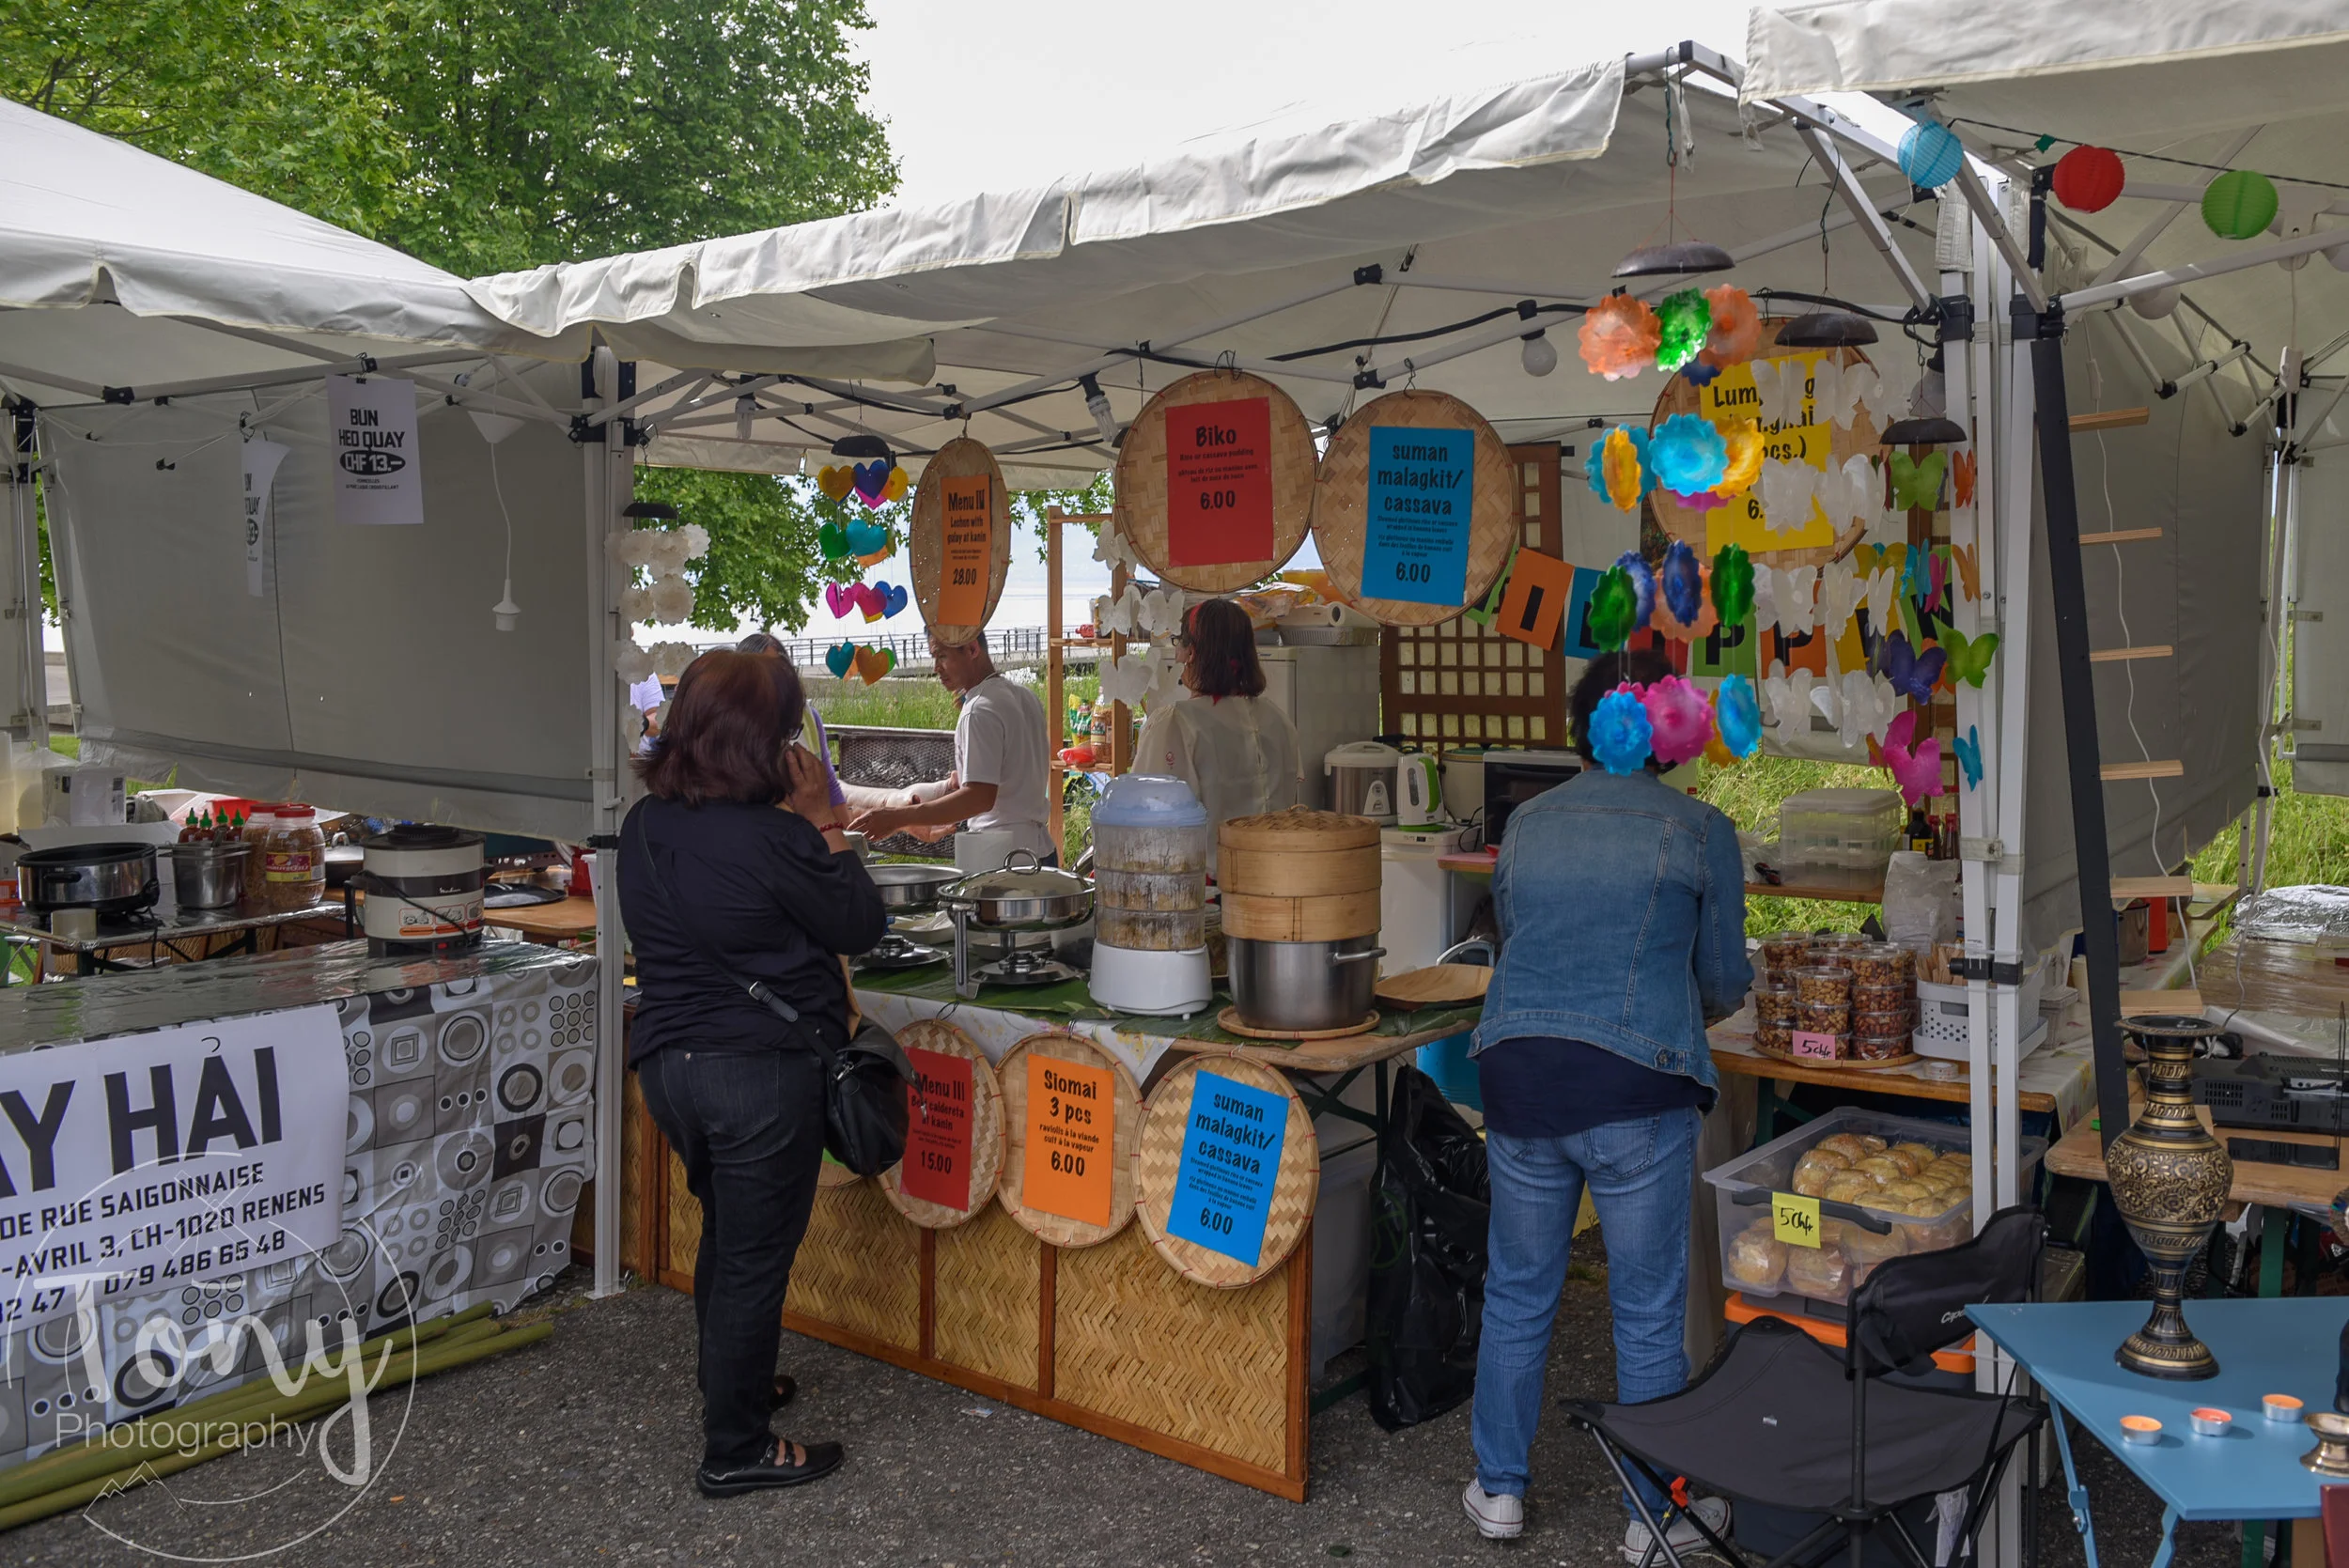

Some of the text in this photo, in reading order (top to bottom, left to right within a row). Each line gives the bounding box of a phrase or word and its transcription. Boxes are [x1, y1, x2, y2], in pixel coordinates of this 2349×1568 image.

[363, 430, 405, 451] QUAY
[1196, 425, 1237, 447] Biko
[345, 453, 367, 472] CHF
[1392, 444, 1448, 462] suman
[1377, 466, 1464, 491] malagkit/
[948, 491, 974, 512] Menu
[1200, 489, 1236, 510] 6.00
[1384, 496, 1452, 515] cassava
[953, 567, 977, 585] 28.00
[1396, 562, 1431, 583] 6.00
[1801, 1039, 1818, 1054] 5
[953, 1080, 965, 1102] III
[1044, 1069, 1097, 1100] Siomai
[929, 1101, 964, 1119] caldereta
[1050, 1096, 1092, 1125] 3 pcs
[1213, 1093, 1264, 1123] suman
[931, 1115, 953, 1131] kanin
[1195, 1113, 1276, 1151] malagkit/
[1039, 1124, 1064, 1136] raviolis
[1070, 1128, 1077, 1139] la
[1078, 1132, 1099, 1144] viande
[1044, 1135, 1057, 1144] cuit
[1064, 1138, 1070, 1147] la
[1071, 1141, 1094, 1153] vapeur
[921, 1150, 952, 1174] 15.00
[1050, 1150, 1085, 1177] 6.00
[1198, 1141, 1261, 1174] cassava
[0, 1161, 264, 1239] DE RUE SAIGONNAISE
[99, 1234, 124, 1259] 3,
[131, 1205, 235, 1251] CH-1020
[242, 1183, 326, 1224] RENENS
[1200, 1206, 1234, 1235] 6.00
[1781, 1207, 1796, 1226] 5
[31, 1286, 65, 1313] 47
[103, 1265, 154, 1296] 079
[163, 1250, 211, 1280] 486
[220, 1238, 250, 1264] 65
[256, 1229, 286, 1255] 48
